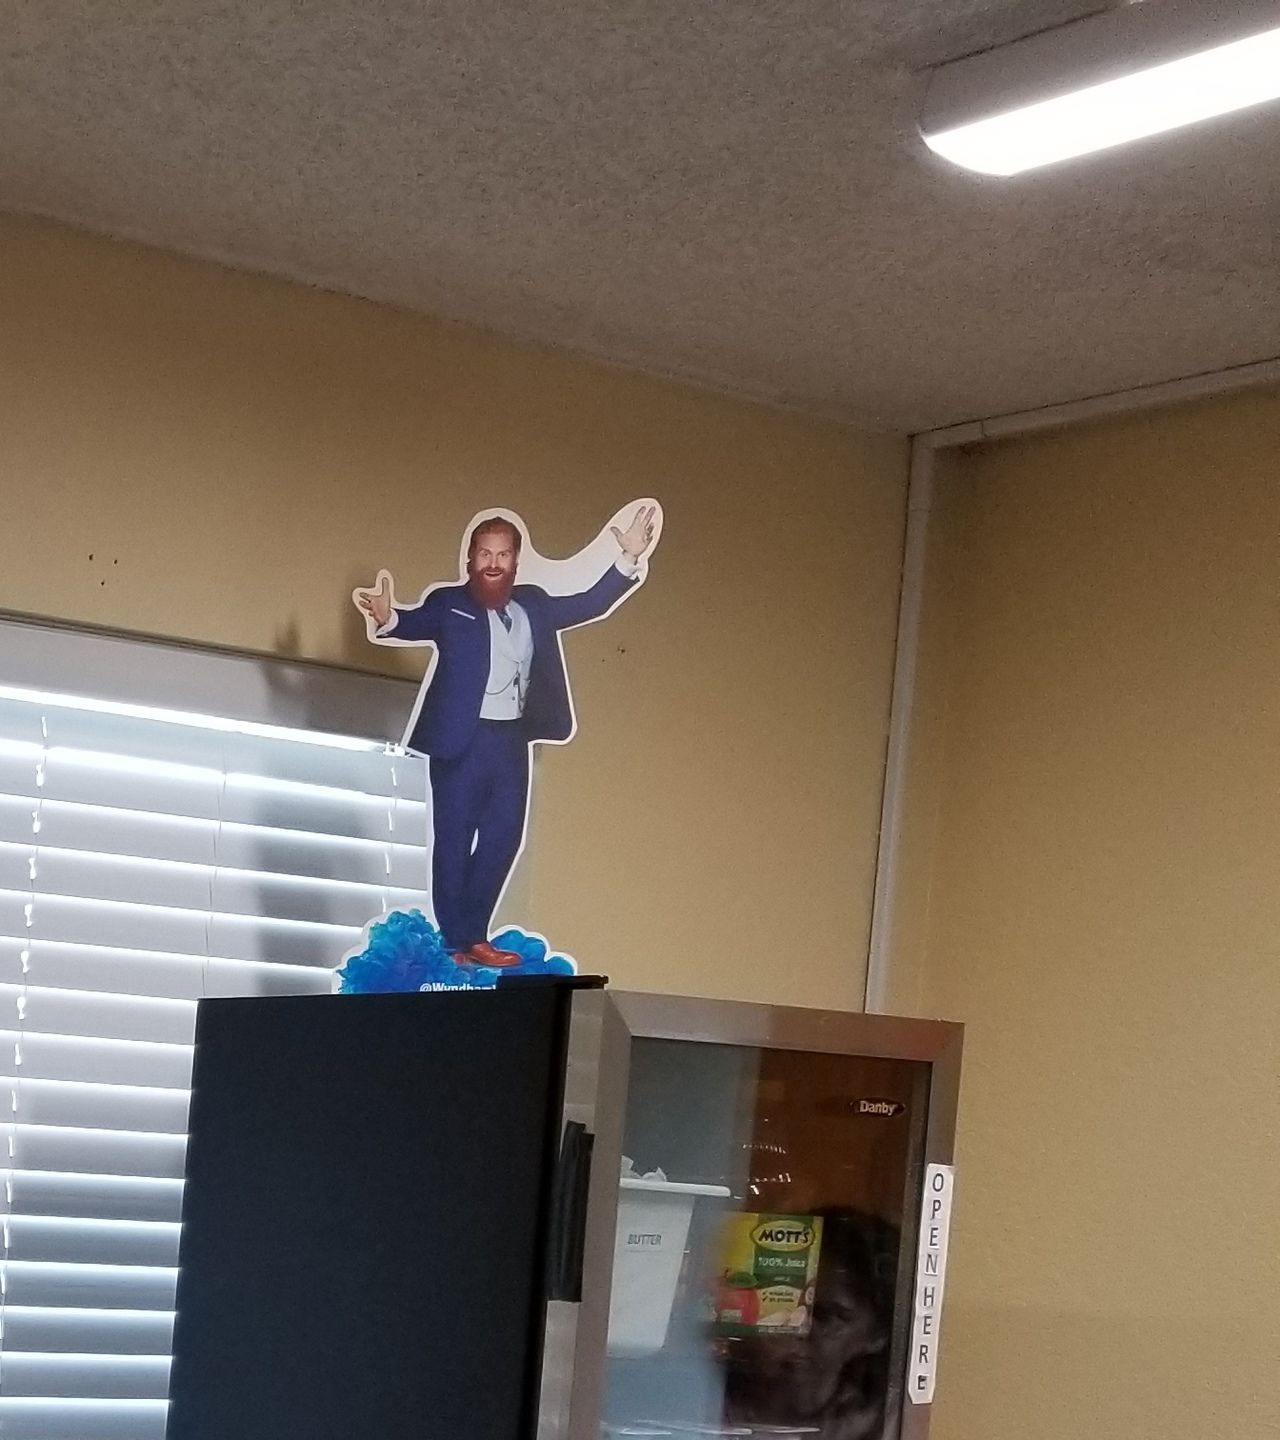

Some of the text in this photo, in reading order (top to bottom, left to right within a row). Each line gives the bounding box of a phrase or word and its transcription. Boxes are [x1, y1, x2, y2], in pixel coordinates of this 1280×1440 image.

[860, 1100, 896, 1116] Danby
[627, 1233, 662, 1246] BUTTER
[758, 1226, 810, 1244] MOTT'S
[758, 1257, 783, 1268] 100%
[917, 1172, 944, 1391] OPEN HERE
